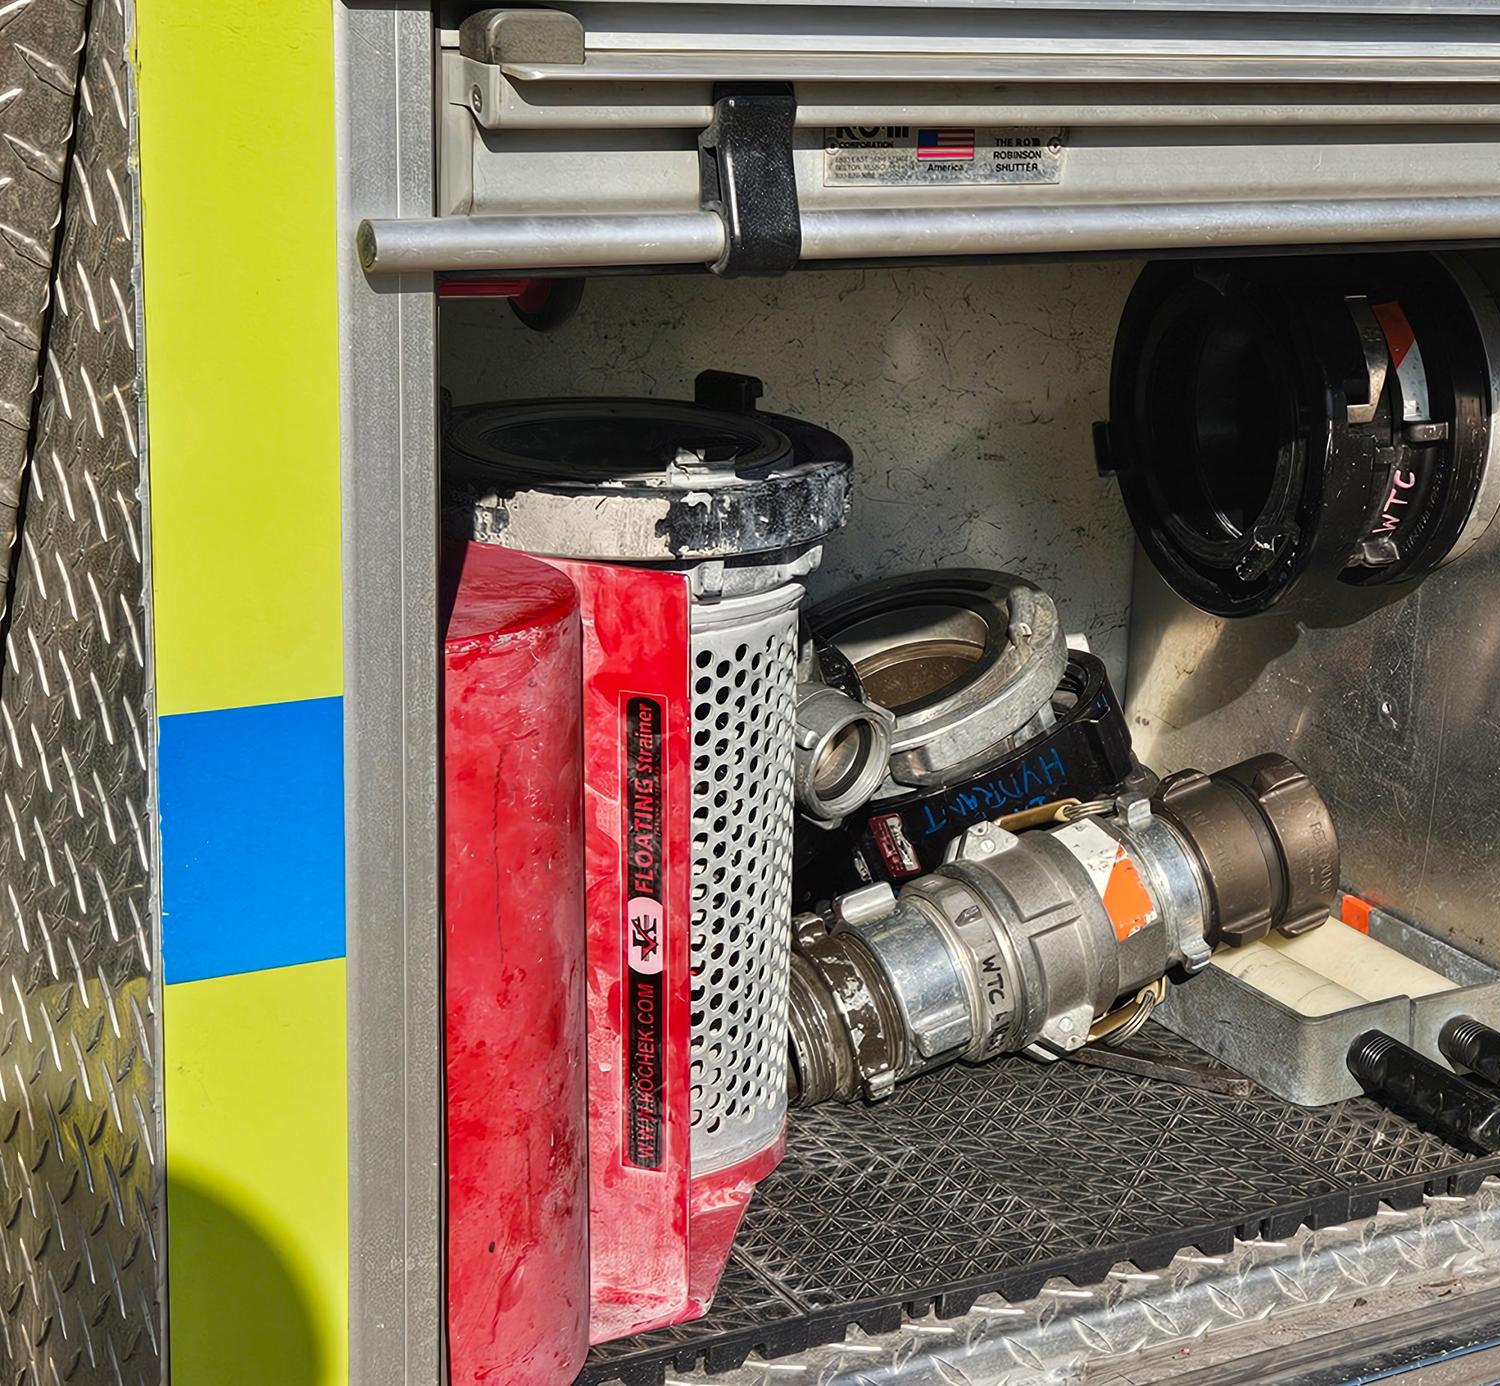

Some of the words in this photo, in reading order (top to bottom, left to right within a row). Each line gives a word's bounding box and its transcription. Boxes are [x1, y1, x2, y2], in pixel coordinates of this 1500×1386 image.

[993, 150, 1042, 160] ROBINSON
[995, 138, 1014, 147] THE
[927, 163, 964, 172] America
[995, 163, 1039, 172] SHUTTER
[1372, 469, 1416, 534] WTC
[635, 704, 653, 773] Strainer
[634, 777, 654, 893] FLOATING
[982, 954, 1005, 1005] WTC
